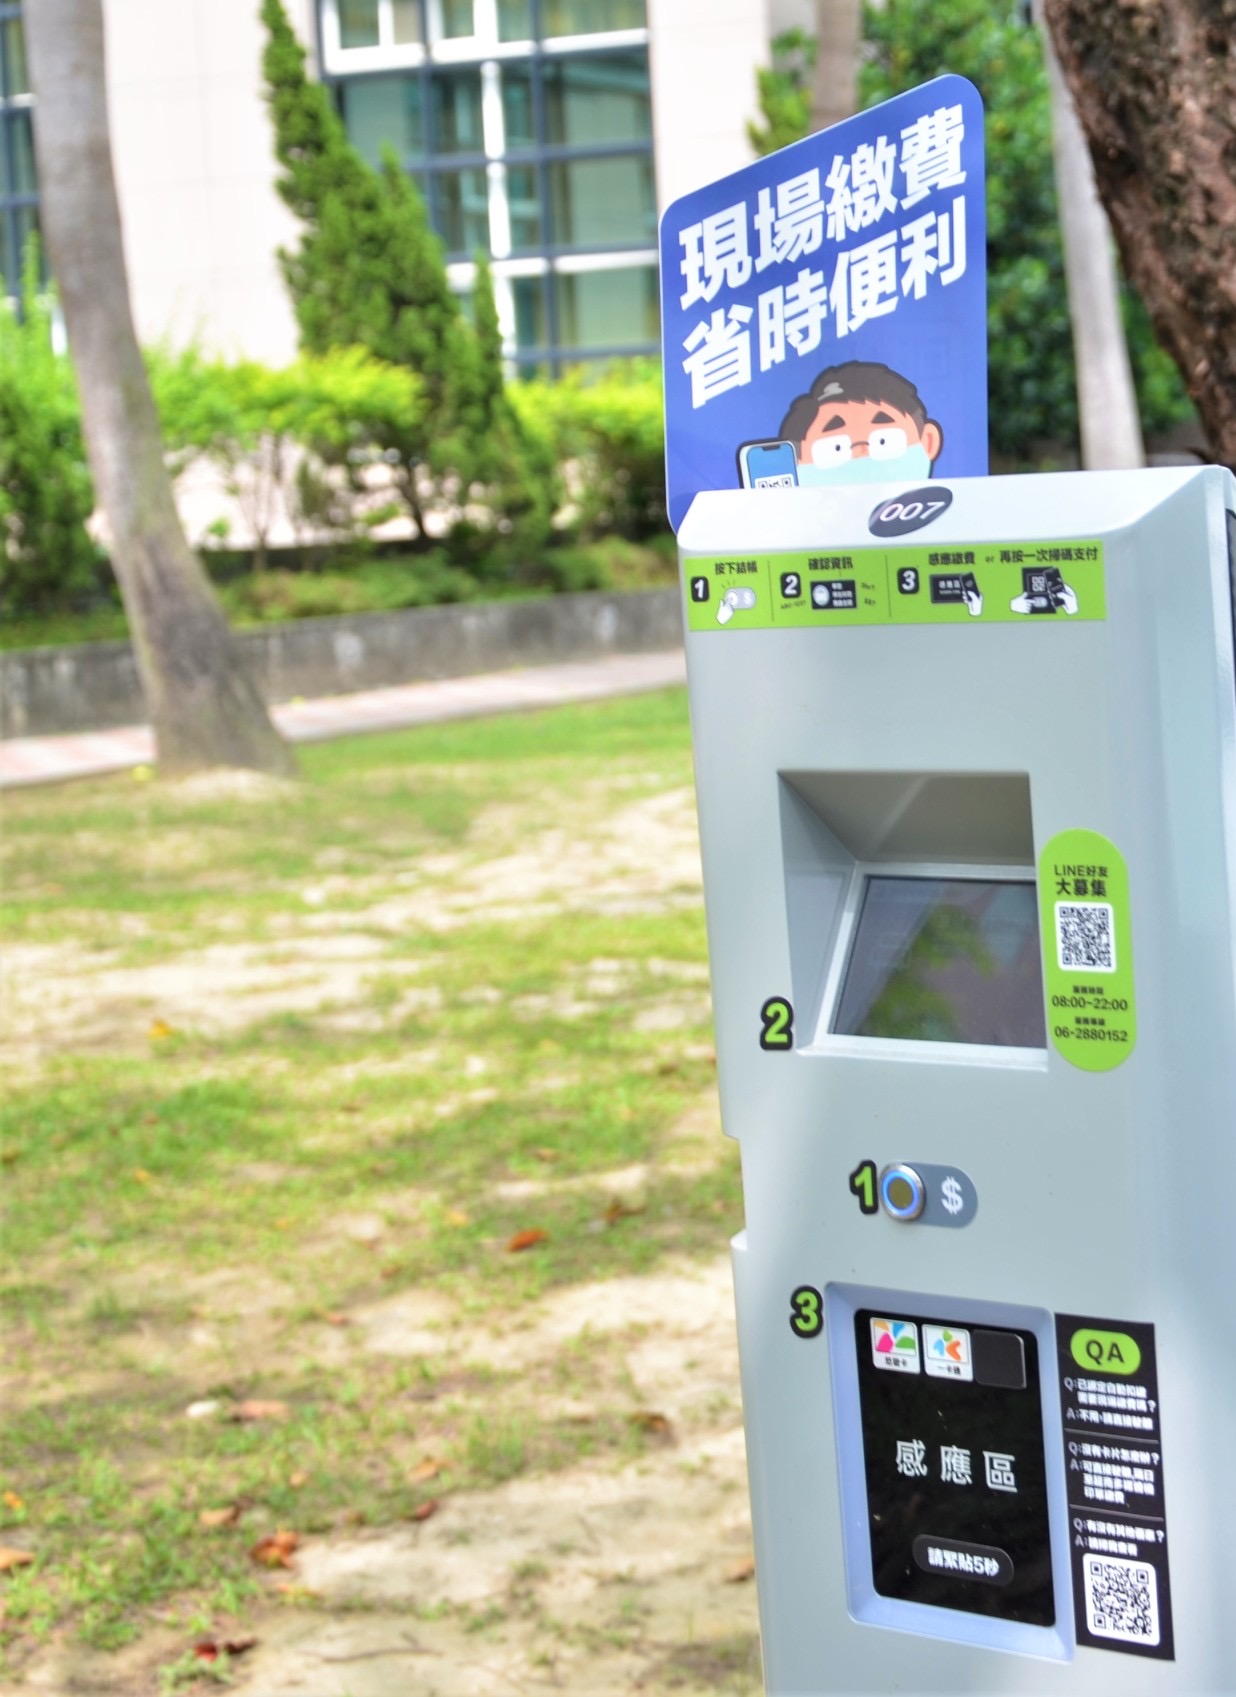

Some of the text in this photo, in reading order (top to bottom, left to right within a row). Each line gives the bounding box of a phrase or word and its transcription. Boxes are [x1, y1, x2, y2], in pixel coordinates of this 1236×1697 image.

[679, 104, 967, 311] 現場繳費
[682, 195, 966, 409] 省時便利
[879, 501, 946, 523] 007
[694, 579, 705, 599] 1
[784, 574, 798, 596] 2
[901, 570, 916, 591] 3
[1054, 864, 1109, 878] LINE好友
[1056, 878, 1108, 897] 大募集
[763, 999, 791, 1047] 2
[1054, 1026, 1129, 1042] 06-2880152
[852, 1163, 876, 1211] 1
[793, 1288, 821, 1335] 3
[1086, 1339, 1125, 1365] QA
[896, 1439, 1018, 1493] 感應區
